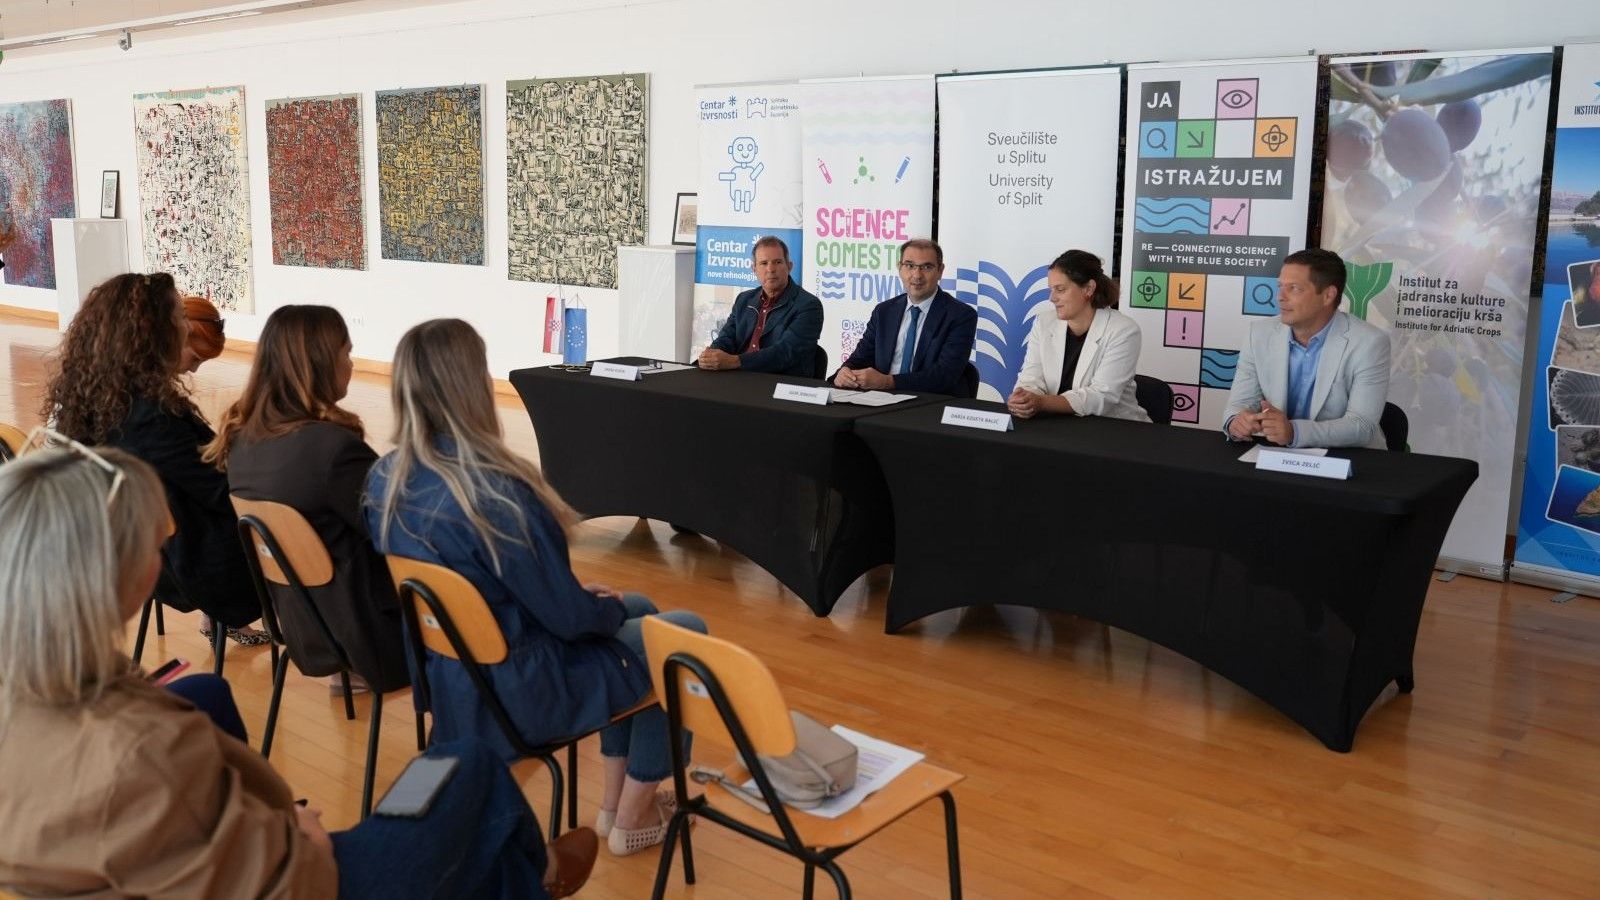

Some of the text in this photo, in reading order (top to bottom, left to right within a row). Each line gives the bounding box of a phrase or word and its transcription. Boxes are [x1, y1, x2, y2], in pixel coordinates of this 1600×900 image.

[700, 100, 725, 110] Centar
[1146, 92, 1173, 109] JA
[700, 109, 738, 120] Izvrsnosti
[987, 131, 1058, 146] Sveučilište
[997, 150, 1047, 167] u Splitu
[989, 173, 1054, 190] University
[1144, 165, 1283, 186] ISTRAŽUJEM
[998, 191, 1044, 208] of Split
[816, 207, 910, 241] SCIENCE
[706, 238, 748, 253] Centar
[1141, 242, 1153, 251] RE
[1171, 244, 1233, 254] CONNECTING
[1235, 246, 1277, 256] SCIENCE
[707, 253, 754, 269] Izvrsno
[815, 241, 881, 270] COMES
[1148, 255, 1268, 267] WITH THE BLUE SOCIETY
[707, 270, 722, 278] nove
[1399, 275, 1458, 290] Institut za
[1397, 289, 1506, 308] jadranske kulture
[1403, 305, 1471, 322] melioraciju
[1474, 307, 1503, 323] krša
[1395, 320, 1502, 338] Institute for Adriatic Crops
